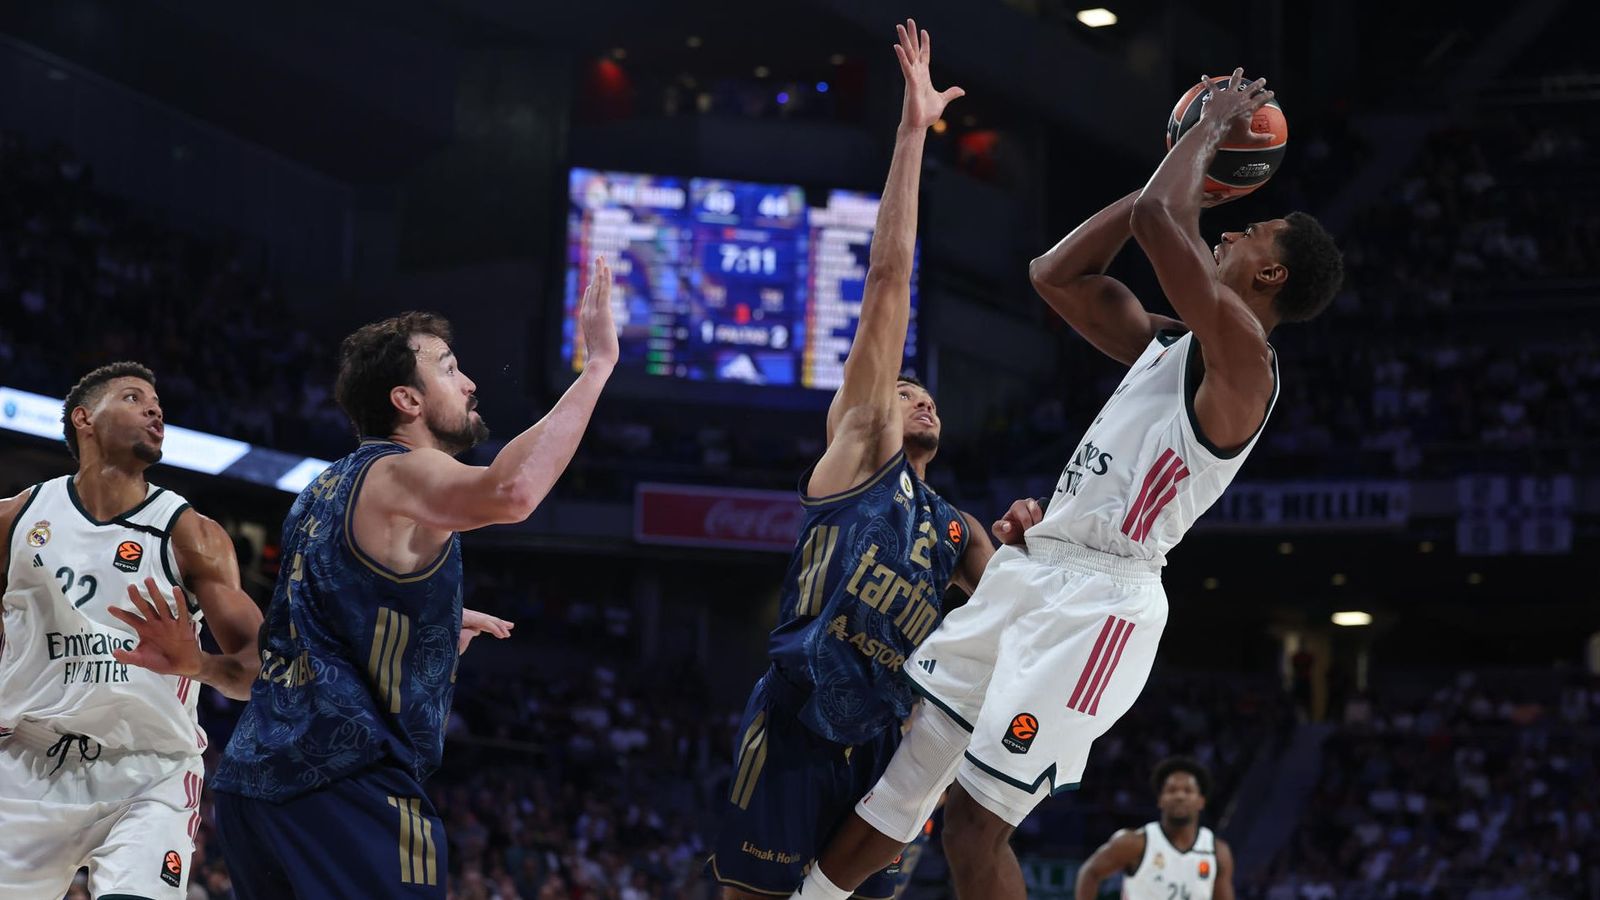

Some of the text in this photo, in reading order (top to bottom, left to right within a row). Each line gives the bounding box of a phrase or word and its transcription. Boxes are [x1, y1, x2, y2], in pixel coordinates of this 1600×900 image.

[719, 243, 778, 275] 7:11
[770, 324, 789, 349] 2
[55, 566, 98, 610] 22
[845, 543, 938, 647] tarfin
[849, 631, 906, 673] ASTOR
[741, 840, 776, 862] Limak
